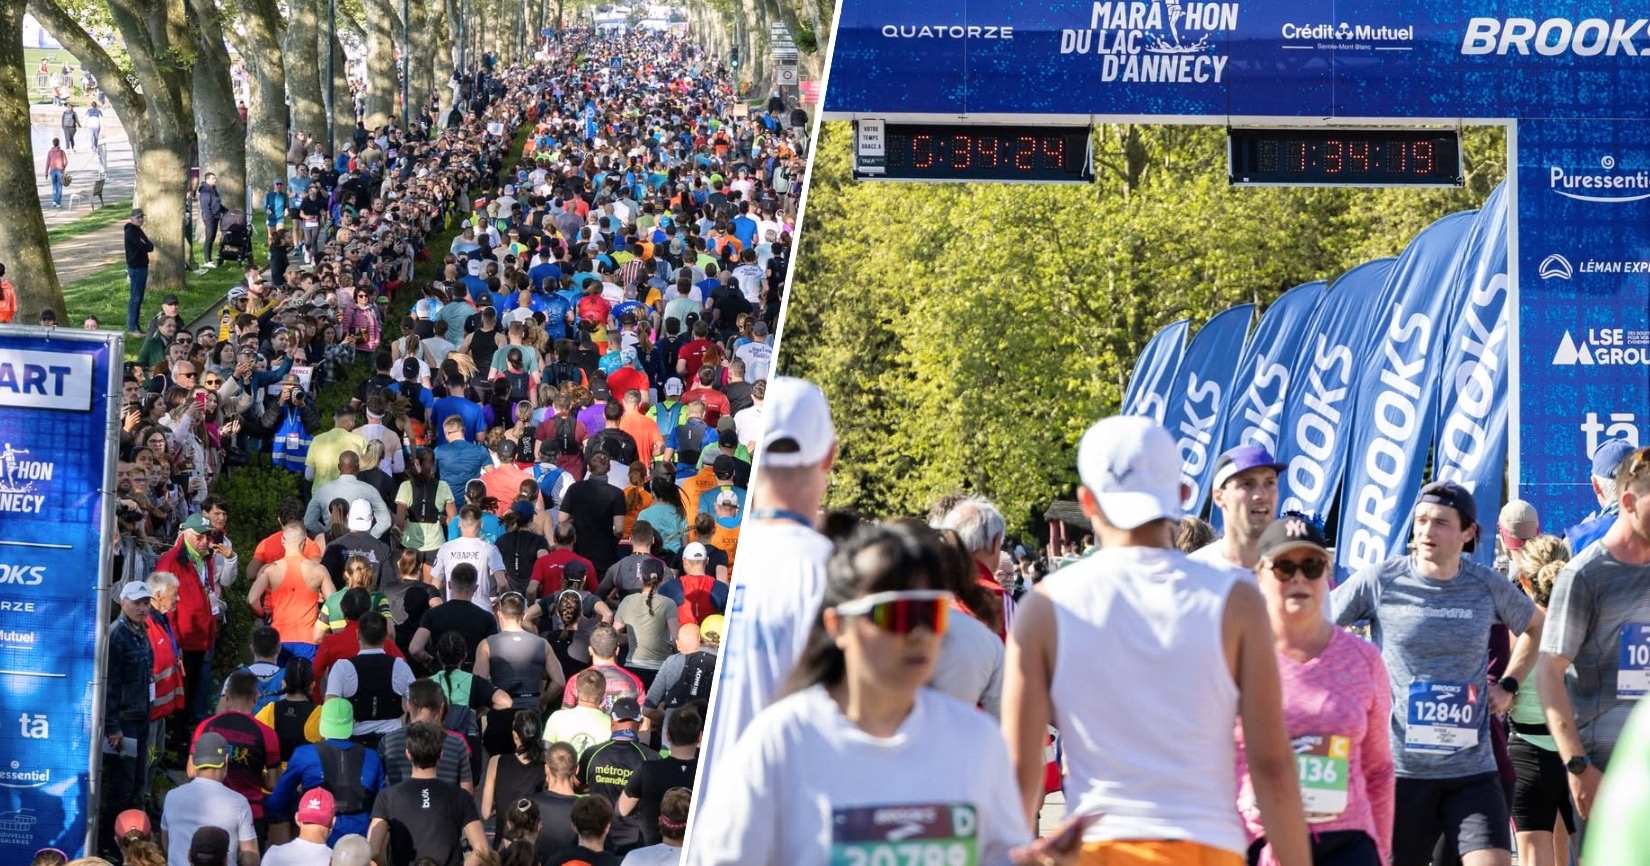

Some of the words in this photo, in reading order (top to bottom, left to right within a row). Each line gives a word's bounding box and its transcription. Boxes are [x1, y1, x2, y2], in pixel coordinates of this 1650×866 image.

[882, 24, 1014, 39] QUATORZE
[1060, 29, 1097, 54] DU
[1097, 29, 1144, 55] LAC
[1282, 22, 1334, 39] Crédit
[1355, 25, 1413, 40] Mutuel
[1461, 17, 1650, 56] BROOK
[1355, 43, 1372, 51] Blanc
[1101, 54, 1229, 83] D'ANNECY
[1300, 140, 1433, 173] 1:34:19
[1551, 166, 1650, 188] Puressenti
[1579, 259, 1622, 273] LÉMAN
[1623, 261, 1650, 273] EXP
[1589, 328, 1624, 346] LSE
[0, 362, 71, 396] ART
[1349, 302, 1431, 571] BROOKS
[1628, 644, 1650, 666] 10
[1431, 684, 1462, 693] BROOKS
[1415, 700, 1472, 724] 12840
[1333, 738, 1347, 756] C
[953, 807, 976, 836] D
